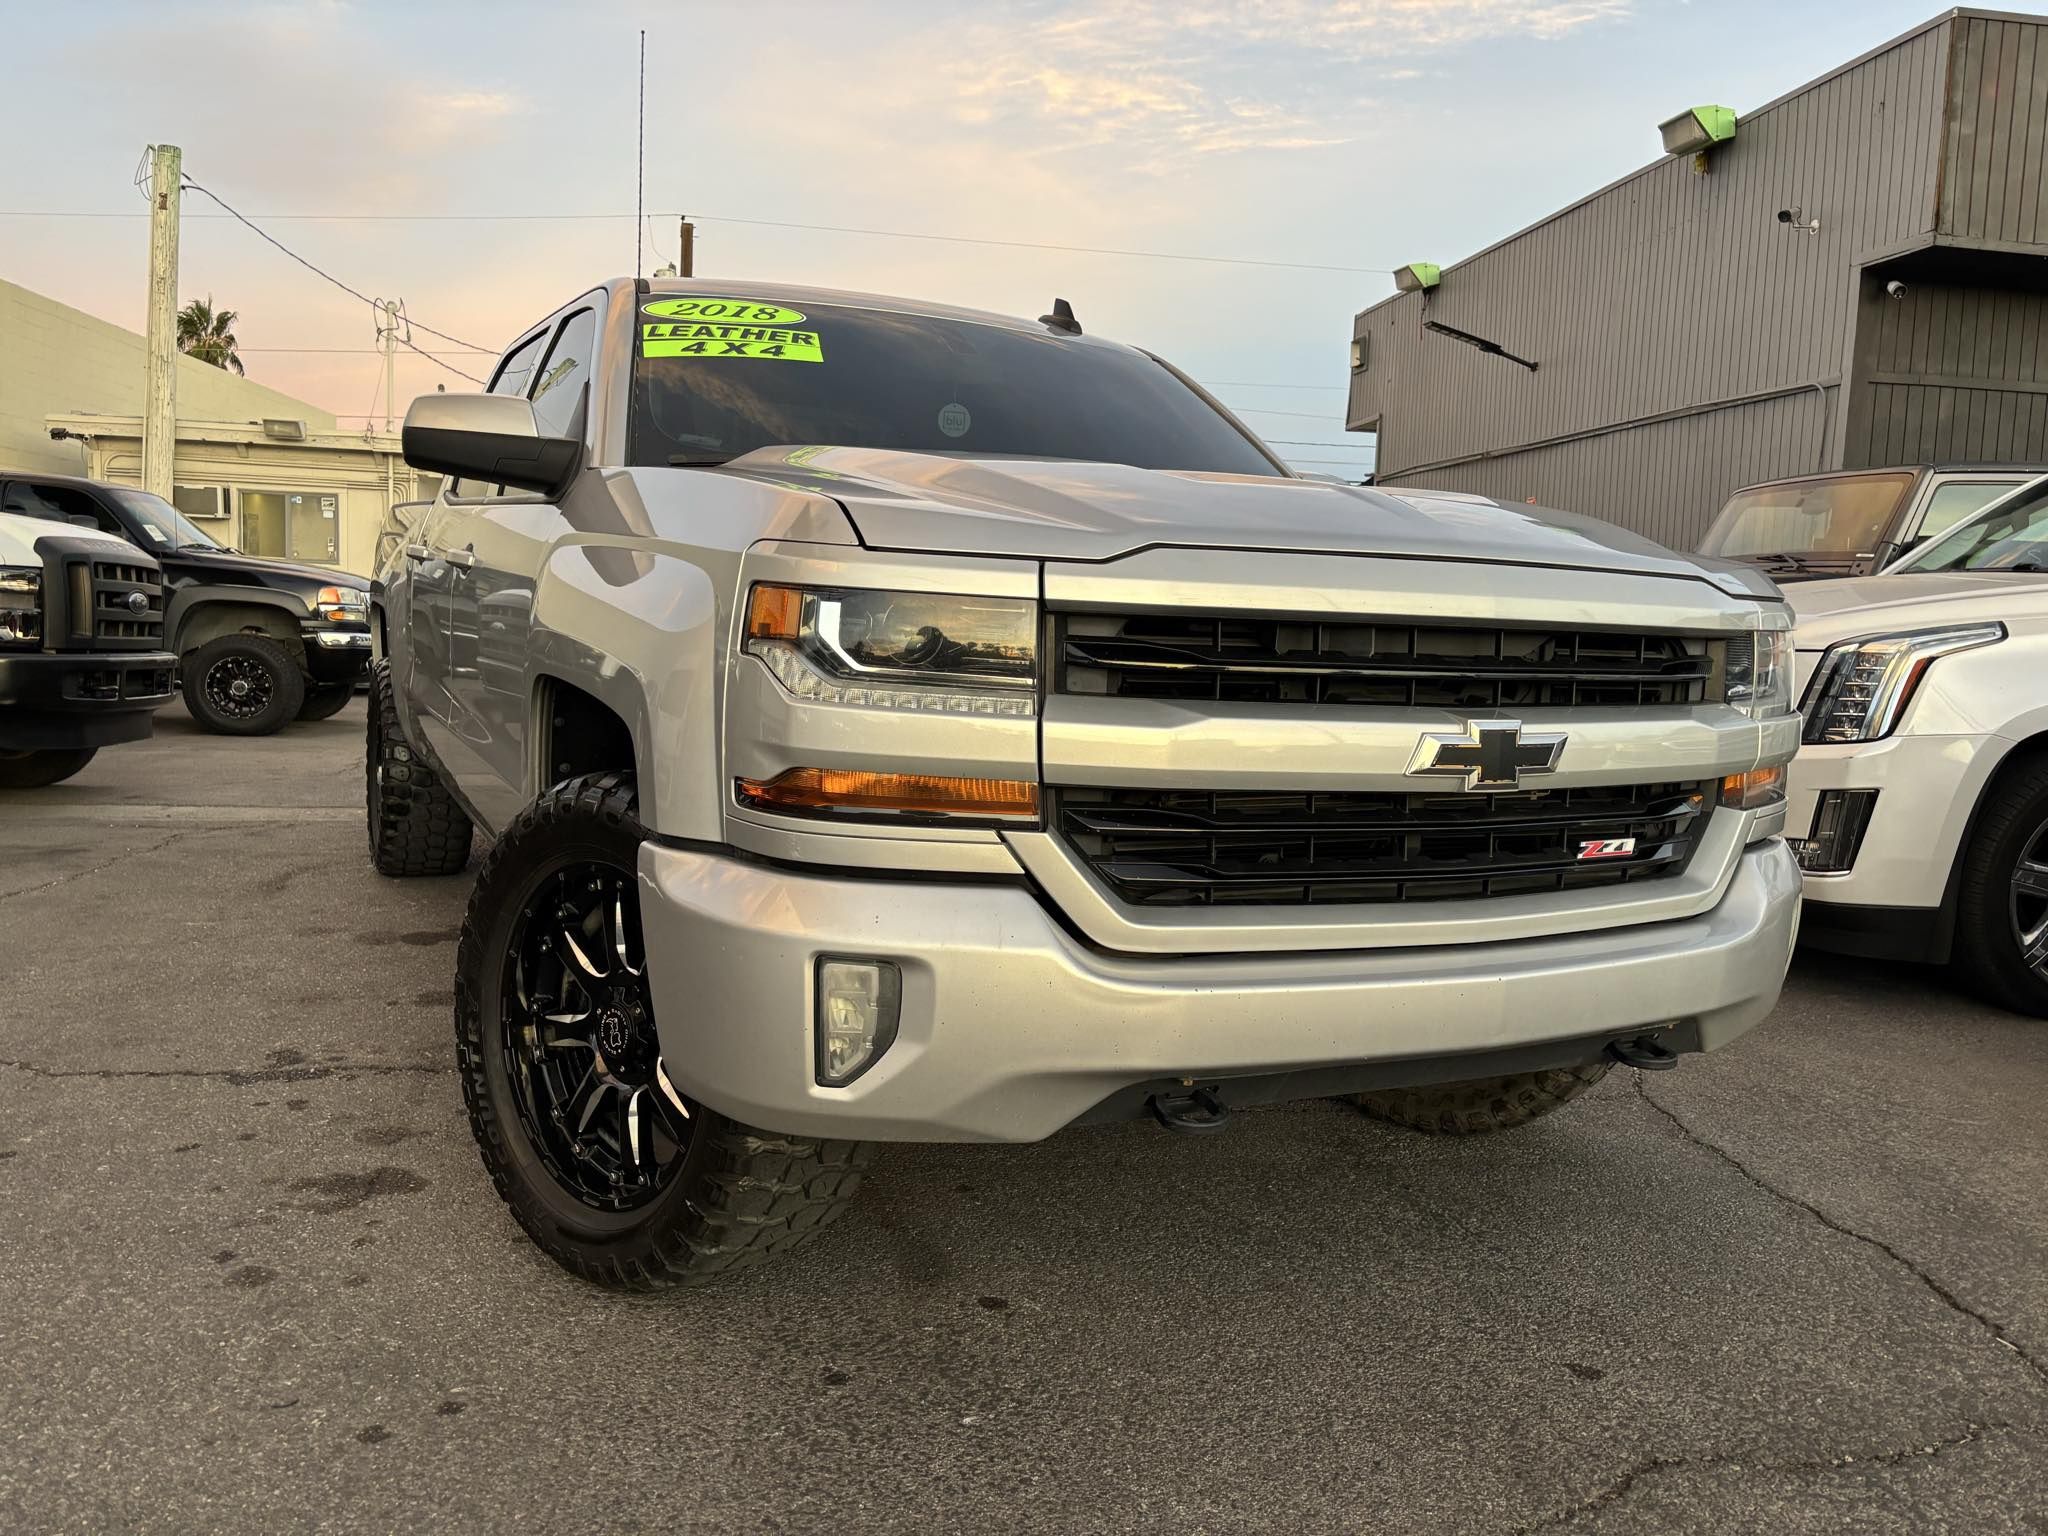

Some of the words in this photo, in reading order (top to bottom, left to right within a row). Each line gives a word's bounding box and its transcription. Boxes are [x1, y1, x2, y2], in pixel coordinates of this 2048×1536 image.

[669, 302, 780, 321] 2018
[646, 325, 815, 346] LEATHER
[1577, 838, 1636, 859] Z71
